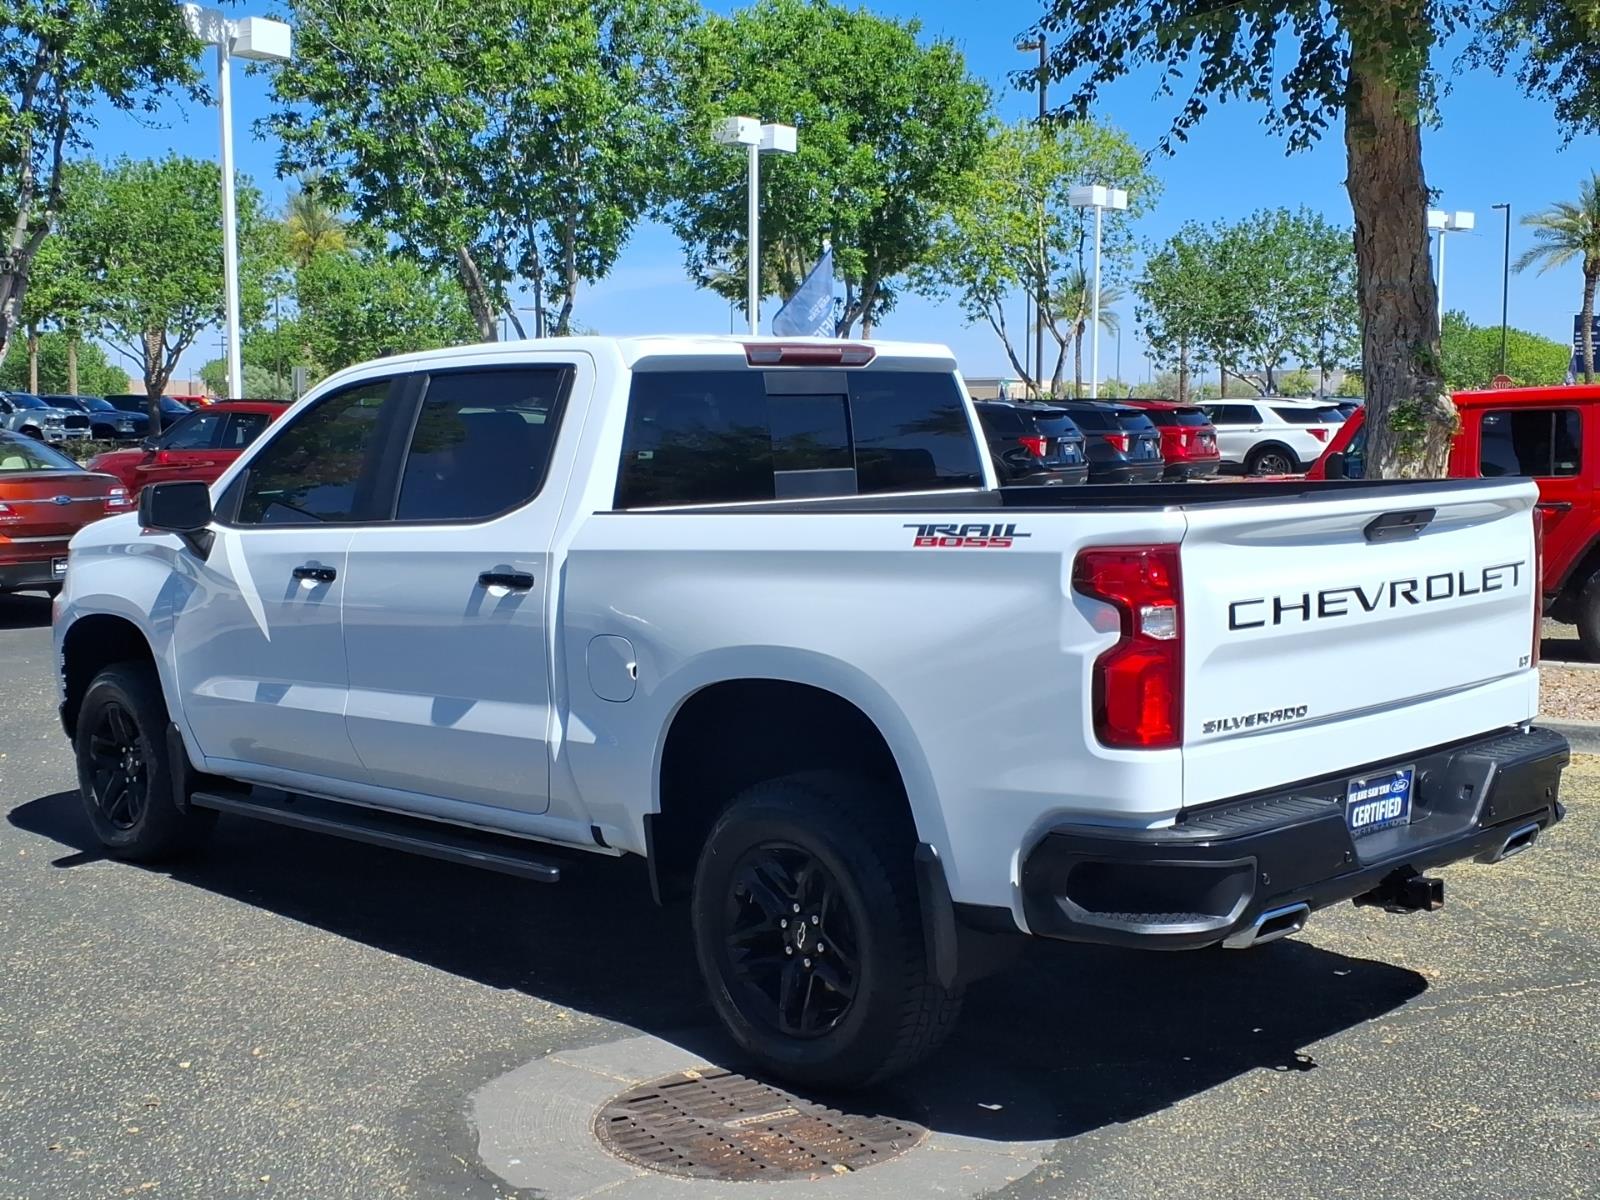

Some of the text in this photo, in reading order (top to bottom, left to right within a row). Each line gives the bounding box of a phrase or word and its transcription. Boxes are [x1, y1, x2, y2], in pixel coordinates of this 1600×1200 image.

[1493, 381, 1511, 389] STOP
[903, 524, 1032, 537] TRAIL
[913, 537, 1013, 548] BOSS
[1228, 560, 1525, 631] CHEVROLET
[1202, 704, 1308, 734] SILVERADO
[1352, 797, 1402, 827] CERTIFIED
